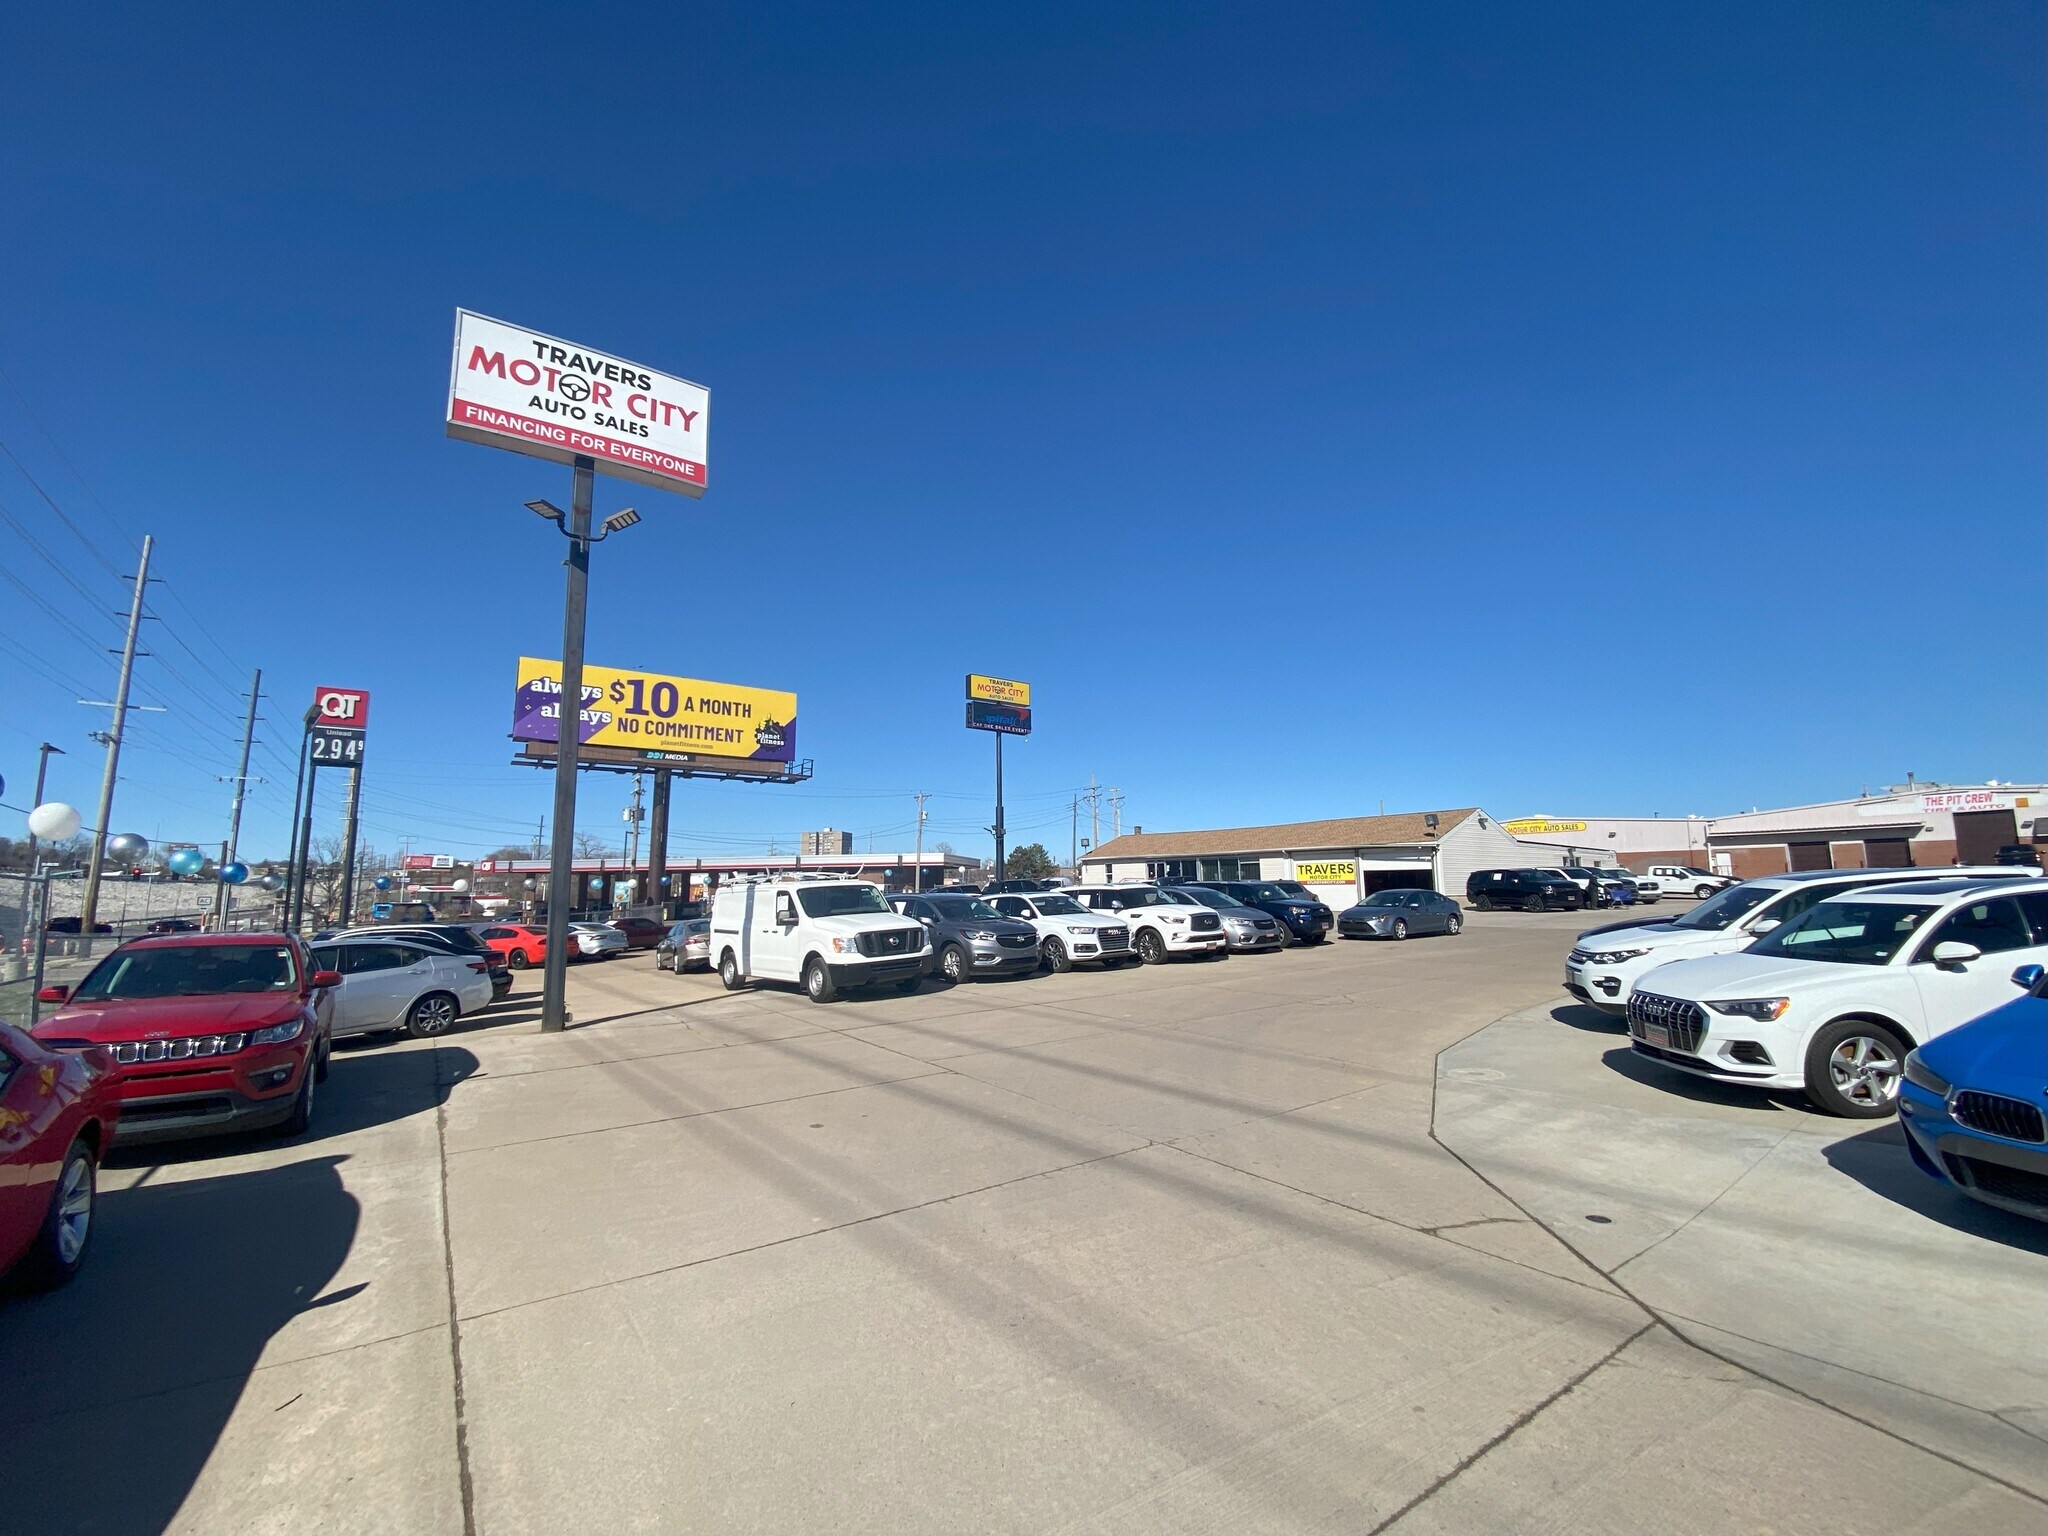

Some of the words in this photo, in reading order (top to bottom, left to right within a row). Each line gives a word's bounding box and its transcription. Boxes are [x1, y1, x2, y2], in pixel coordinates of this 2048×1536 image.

[533, 340, 652, 392] TRAVERS
[468, 345, 613, 409] MOTOR
[627, 394, 699, 433] CITY
[528, 395, 586, 421] AUTO
[594, 412, 649, 438] SALES
[466, 406, 566, 442] FINANCING
[571, 432, 606, 452] FOR
[610, 443, 695, 476] EVERYONE
[989, 679, 1013, 687] TRAVERS
[530, 677, 603, 707] alwys
[977, 684, 1006, 694] MOTOR
[1008, 688, 1024, 697] CITY
[609, 678, 680, 719] $10
[684, 696, 695, 712] A
[699, 698, 752, 719] MONTH
[320, 692, 360, 719] QT
[540, 702, 612, 725] alays
[617, 716, 639, 734] NO
[644, 719, 744, 744] COMMITMENT
[757, 732, 780, 740] planet
[660, 740, 714, 749] planetfitness.com
[760, 737, 785, 746] fitness
[664, 753, 688, 761] MEDIA
[1925, 796, 1943, 806] THE
[1946, 795, 1962, 805] PIT
[1965, 793, 1993, 804] CREW
[1508, 826, 1528, 834] MOTOR
[1529, 825, 1541, 833] CITY
[481, 861, 493, 871] QT
[1298, 864, 1354, 875] TRAVERS
